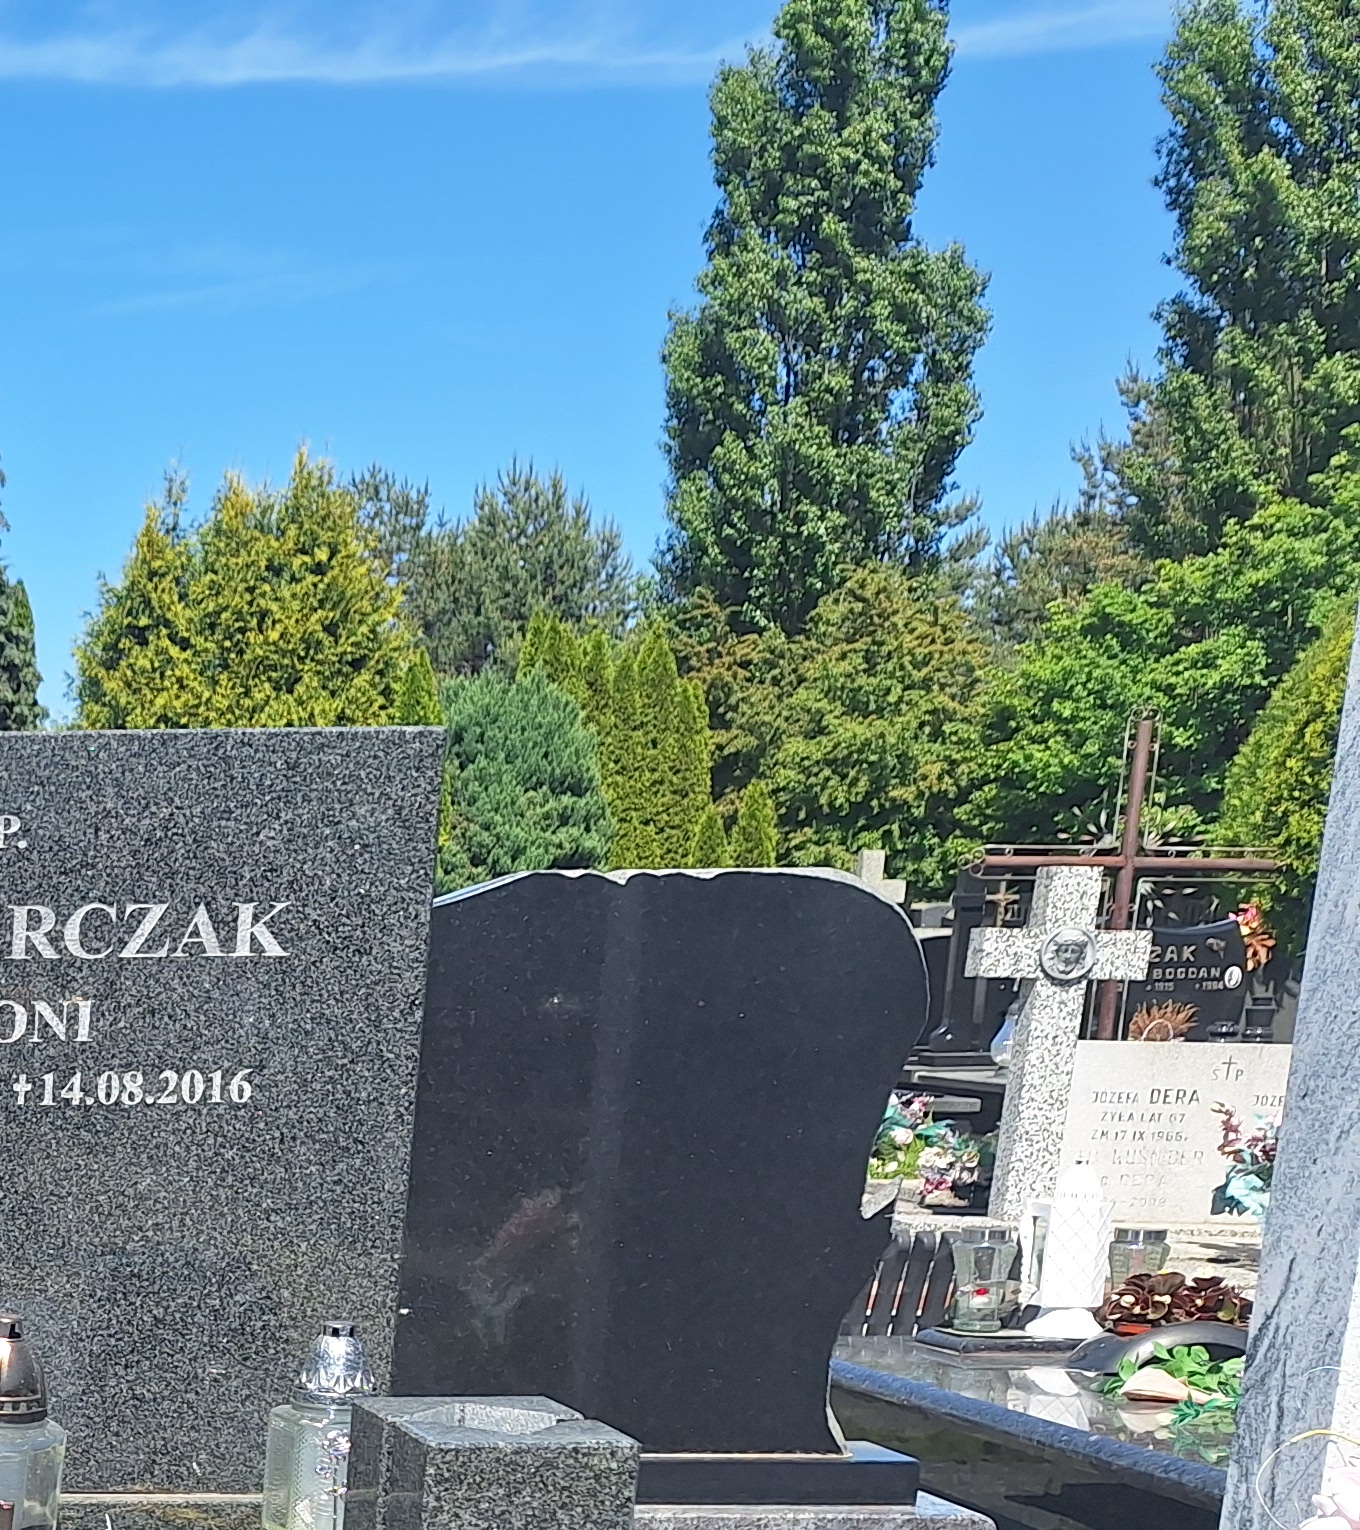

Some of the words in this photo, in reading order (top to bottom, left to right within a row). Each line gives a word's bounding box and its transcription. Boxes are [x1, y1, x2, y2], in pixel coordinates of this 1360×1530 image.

[1152, 967, 1221, 980] BOGDAN
[1149, 1088, 1200, 1105] DERA
[1140, 1112, 1163, 1123] LAT
